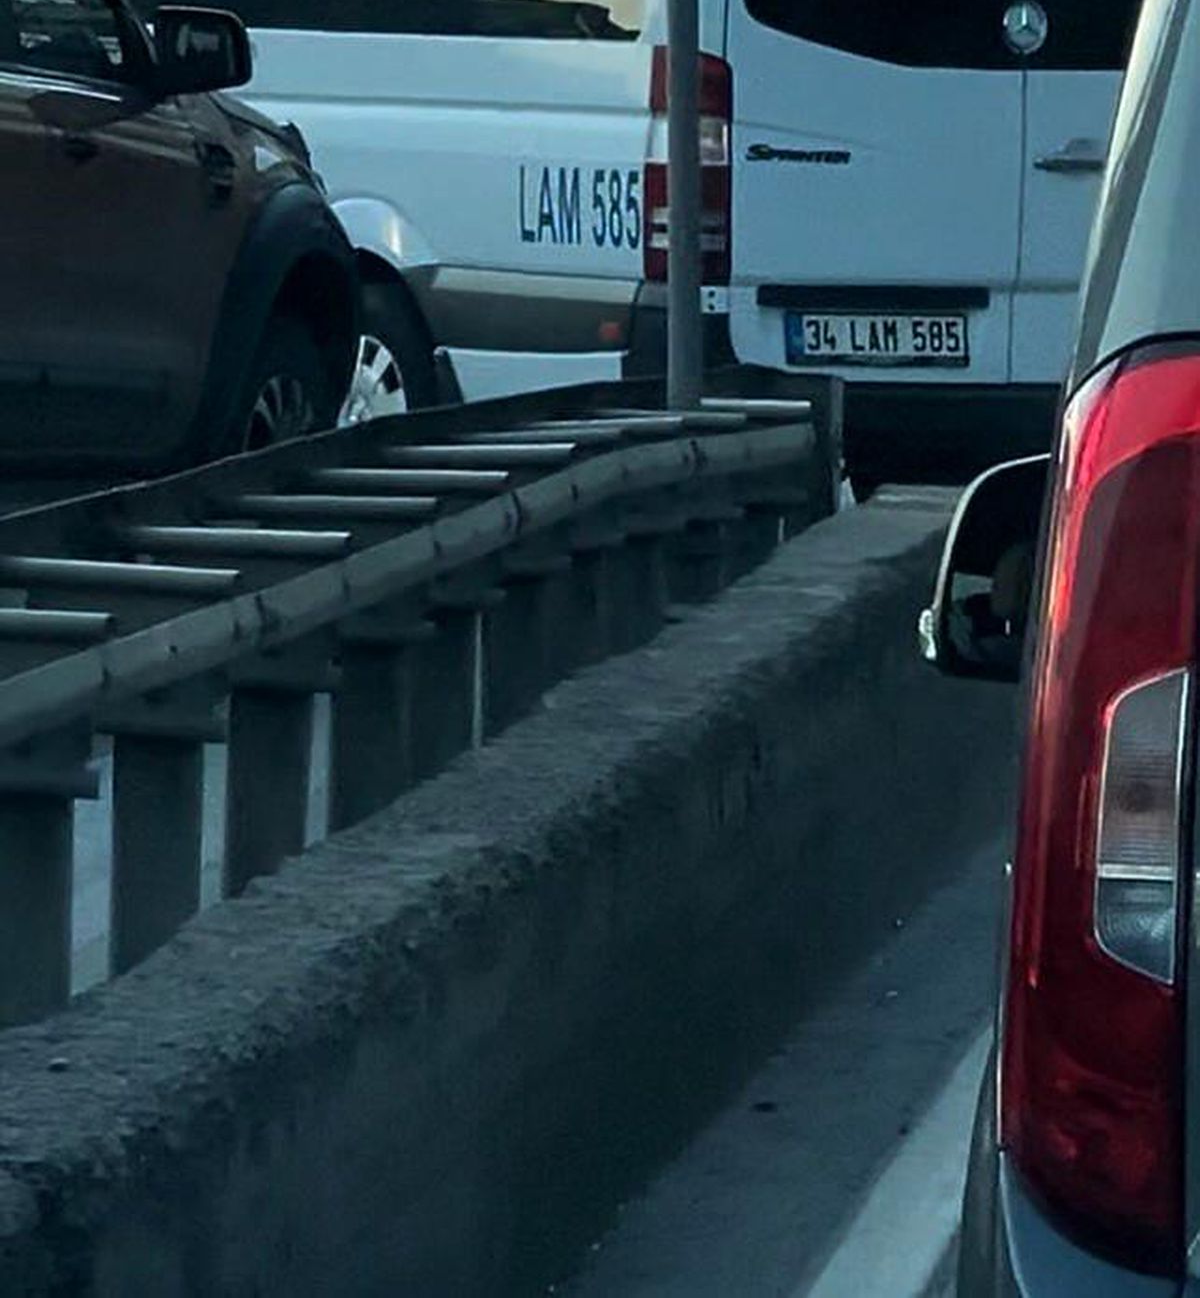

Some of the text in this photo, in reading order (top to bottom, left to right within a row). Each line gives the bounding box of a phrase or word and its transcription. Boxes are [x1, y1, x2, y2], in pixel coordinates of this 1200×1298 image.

[519, 165, 640, 249] LAM 585
[806, 320, 960, 352] 34 LAM 585
